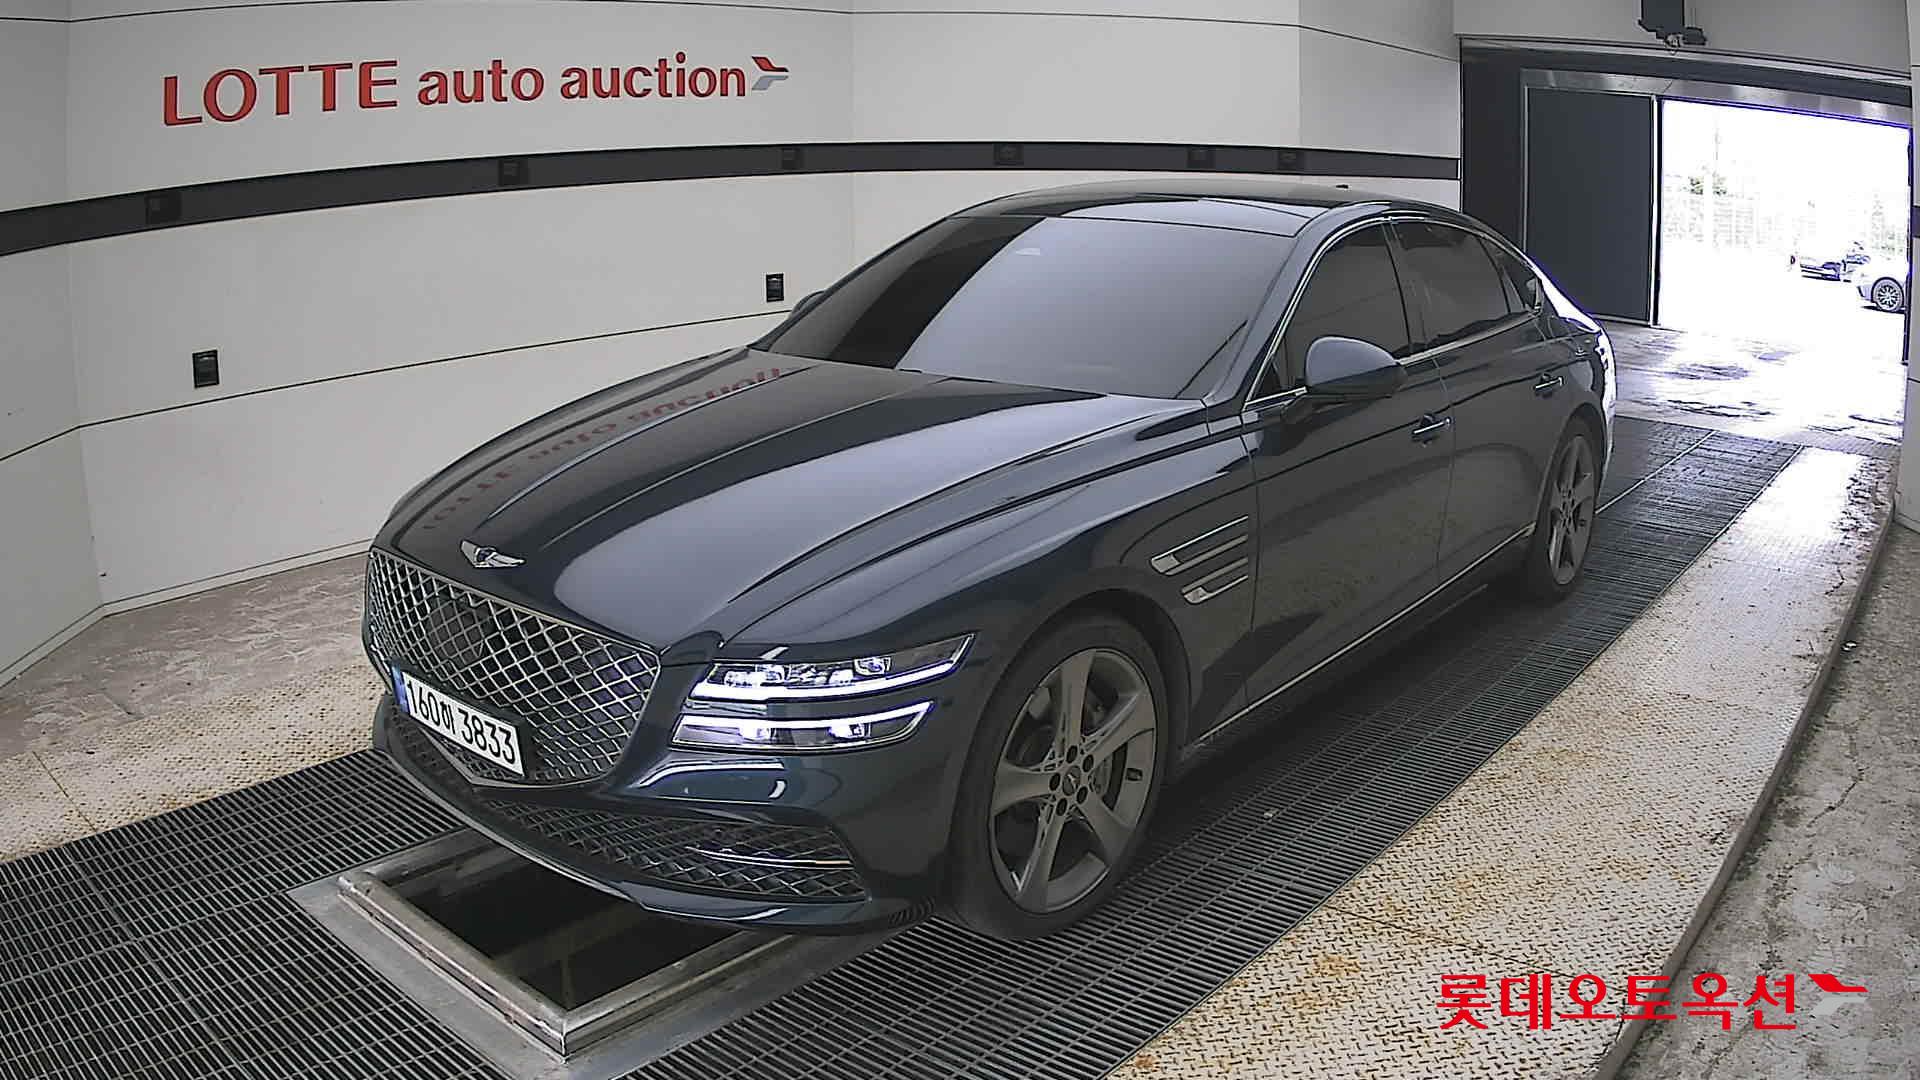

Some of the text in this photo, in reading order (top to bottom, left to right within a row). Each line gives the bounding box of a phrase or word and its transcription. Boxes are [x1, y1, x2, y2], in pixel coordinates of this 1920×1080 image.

[163, 51, 746, 126] LOTTE auto auction
[458, 707, 515, 764] 3833
